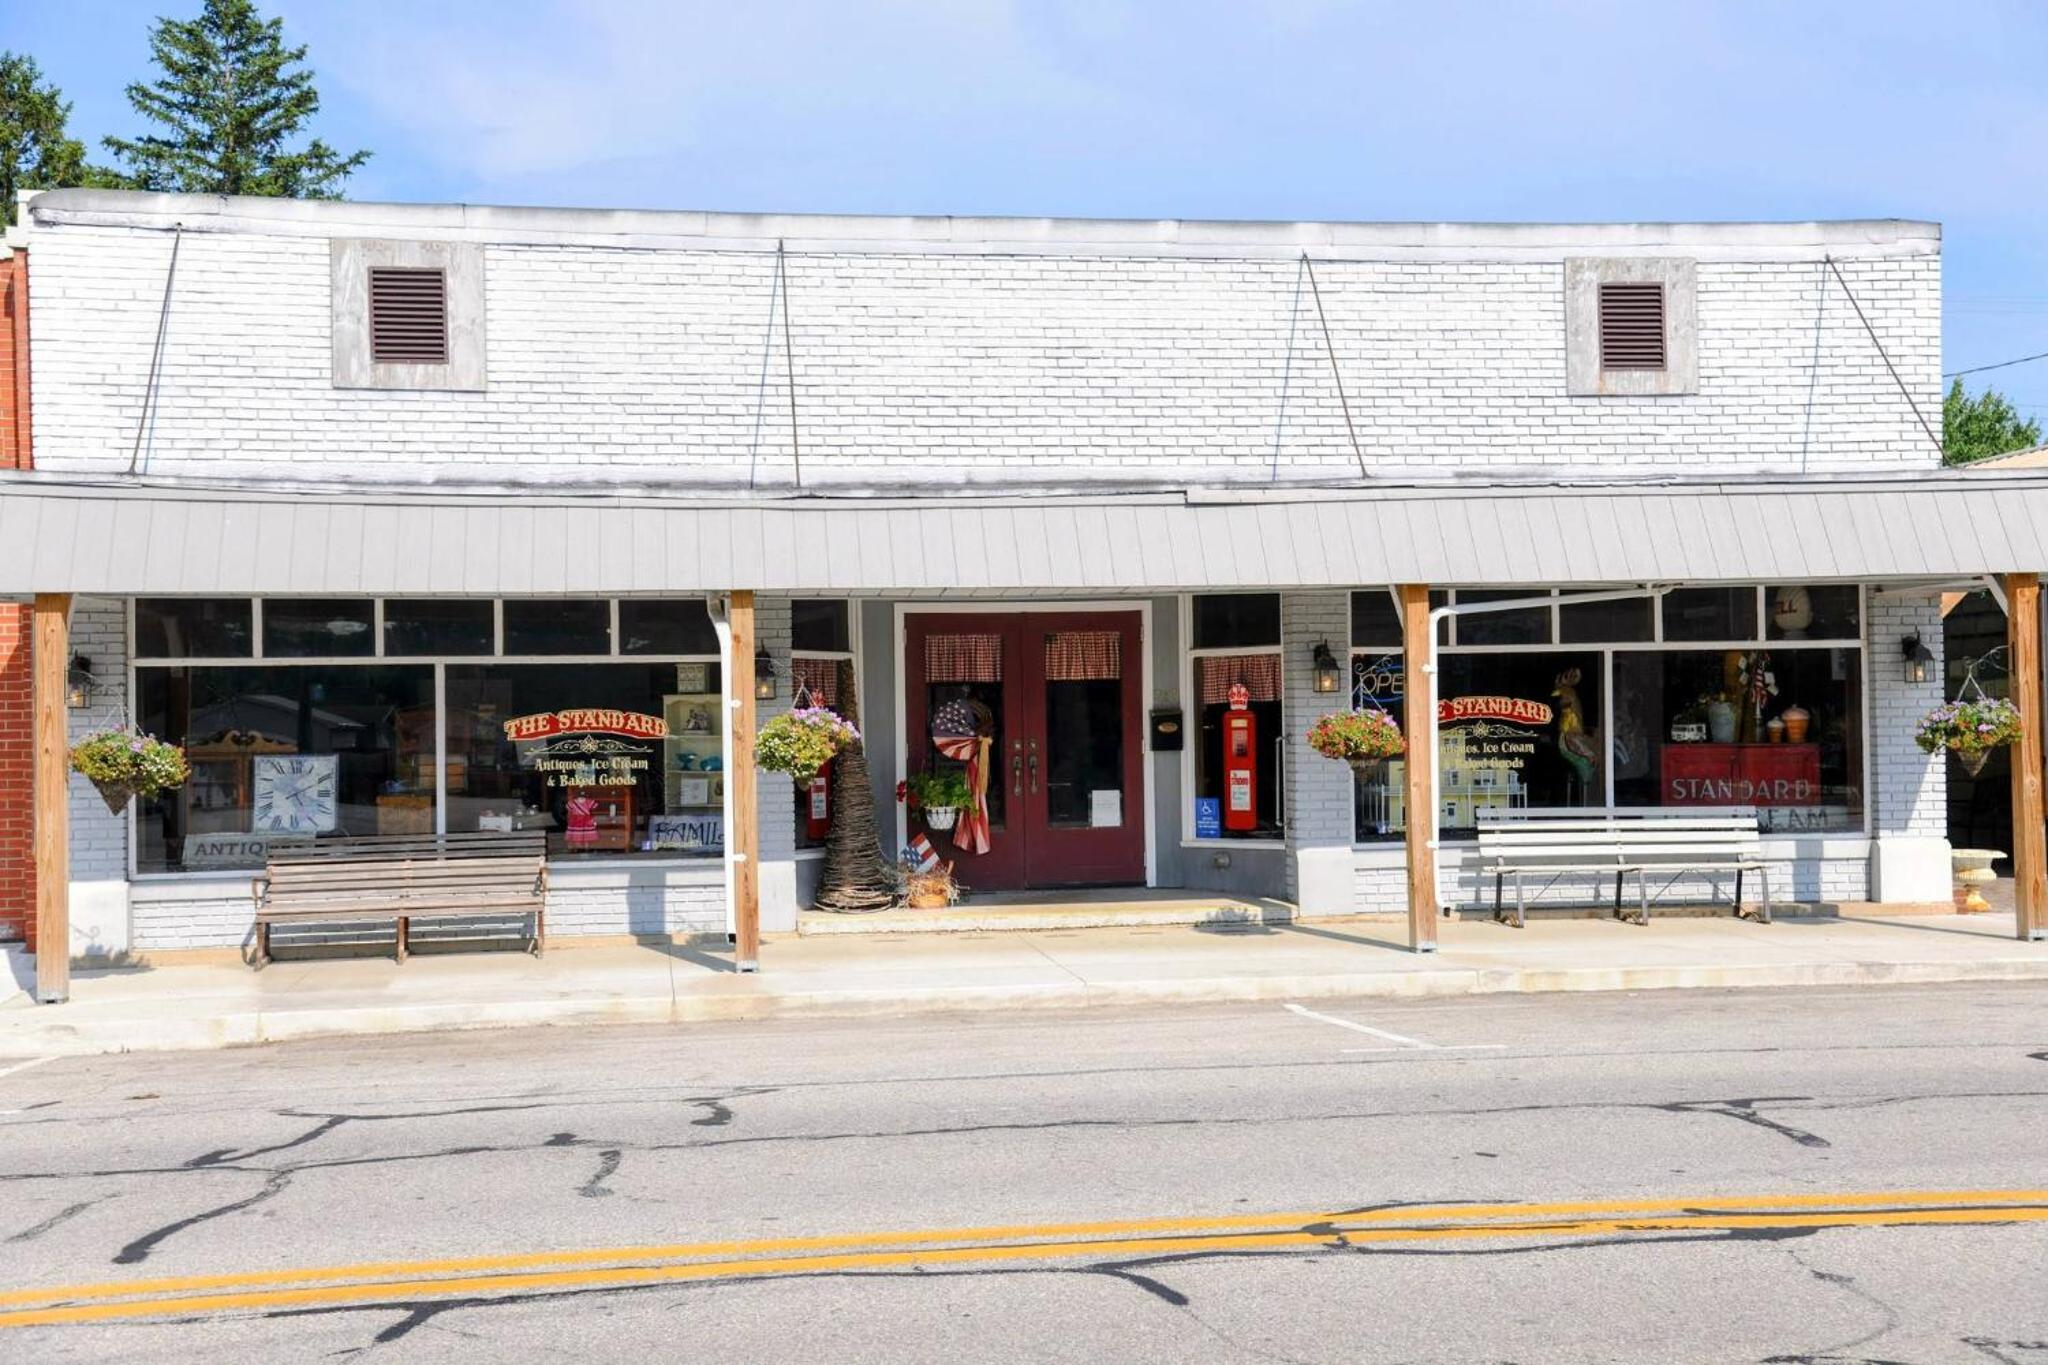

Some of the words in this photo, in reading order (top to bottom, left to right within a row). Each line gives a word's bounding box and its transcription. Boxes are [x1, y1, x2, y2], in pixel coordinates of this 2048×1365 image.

[1453, 696, 1553, 722] STANDARD
[505, 713, 551, 738] THE
[558, 710, 669, 737] STANDARD
[1483, 742, 1499, 753] Ice
[1501, 742, 1535, 754] Cream
[591, 759, 609, 770] Ice
[612, 758, 649, 770] Cream
[546, 776, 556, 787] &
[559, 774, 596, 788] Baked
[599, 774, 638, 786] Goods
[1672, 779, 1812, 800] STANDARD
